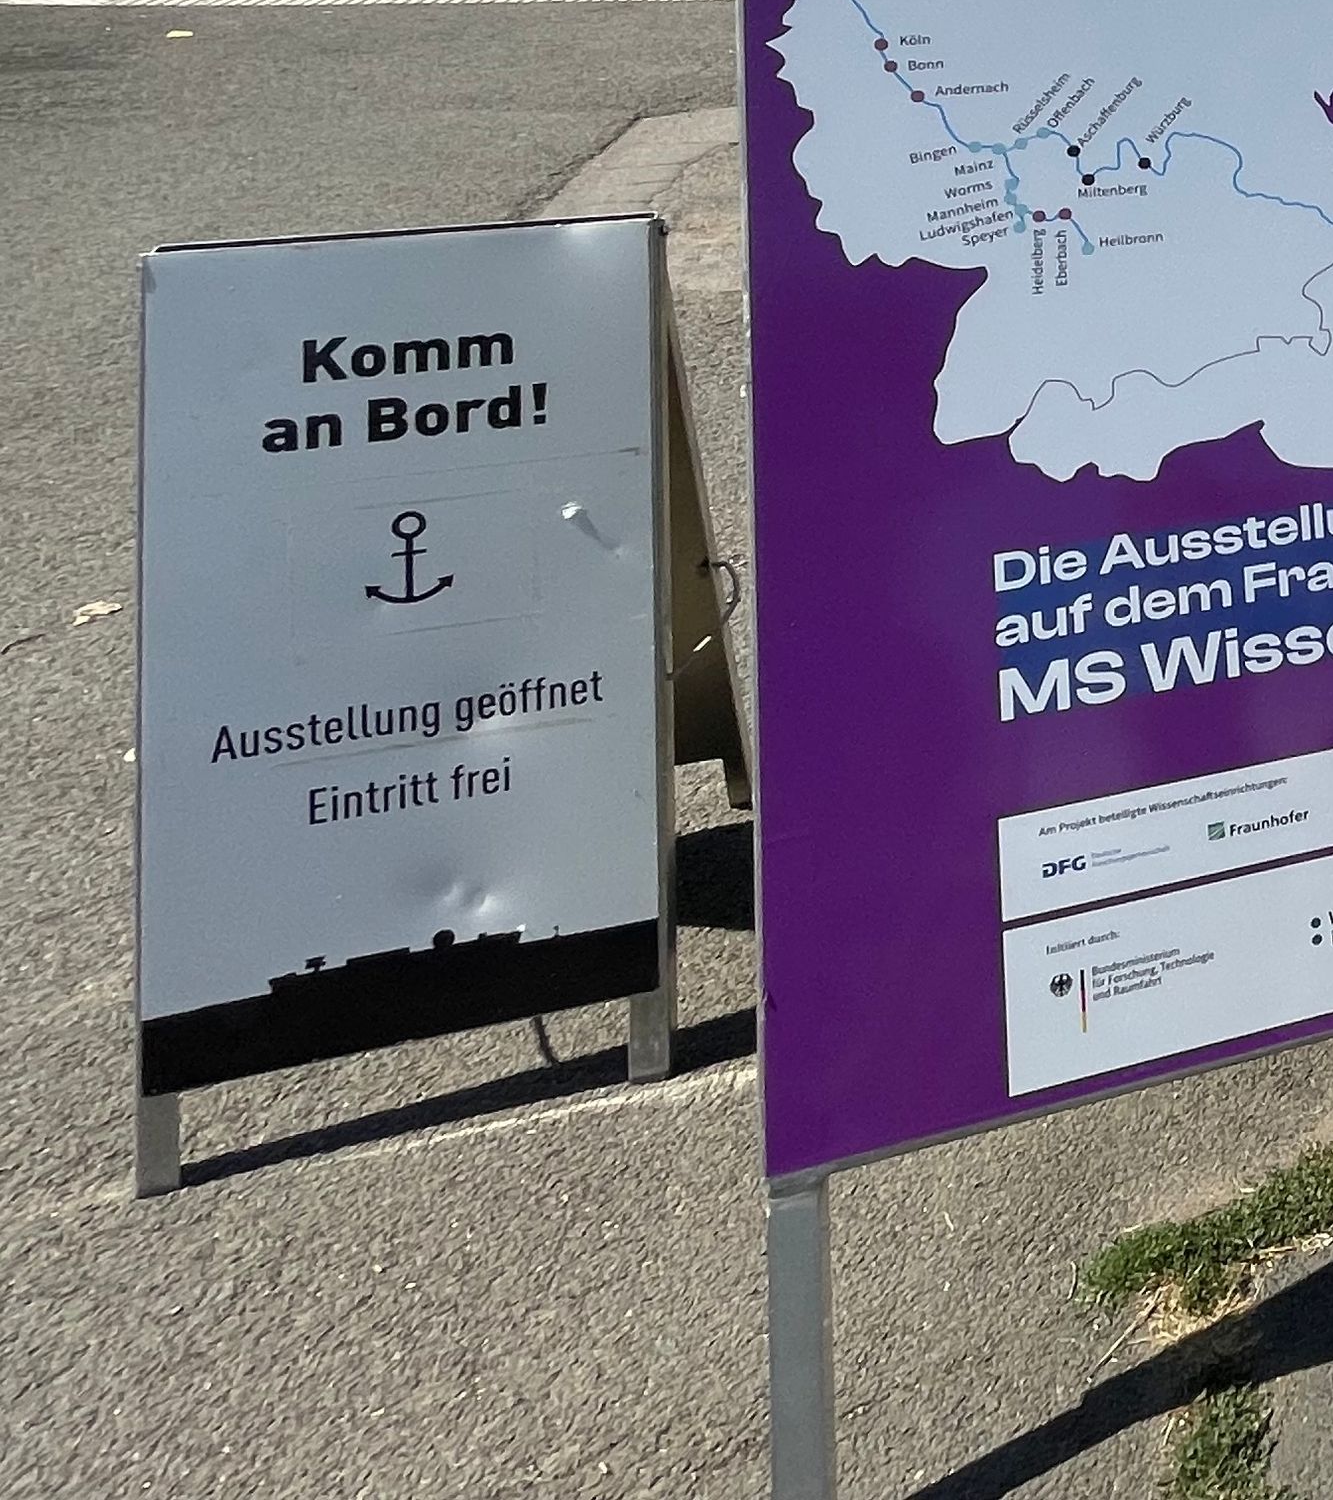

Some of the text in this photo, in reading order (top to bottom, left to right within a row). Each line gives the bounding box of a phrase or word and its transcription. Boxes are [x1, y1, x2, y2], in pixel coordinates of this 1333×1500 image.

[899, 33, 931, 47] Köln
[907, 58, 944, 72] Bonn
[934, 80, 1009, 97] Andernach
[1012, 72, 1071, 135] Rüsselsheim
[1046, 76, 1096, 129] Offenbach
[1077, 76, 1143, 149] Aschaffenburg
[1144, 96, 1192, 145] Würzburg
[909, 145, 957, 165] Bingen
[954, 159, 994, 177] Mainz
[943, 180, 993, 200] Worms
[1077, 184, 1149, 199] Miltenberg
[919, 209, 1014, 241] Ludwigshafen
[926, 197, 999, 223] Mannheim
[961, 226, 1009, 248] Speyer
[1099, 232, 1164, 248] Heilbronn
[1031, 228, 1047, 296] Heidelberg
[1055, 229, 1068, 287] Eberbach
[302, 330, 514, 383] Komm
[261, 382, 548, 453] an Bord!
[993, 545, 1089, 592] Die
[995, 595, 1094, 648] auf
[1104, 574, 1233, 627] dem
[998, 648, 1128, 723] MS
[210, 670, 604, 763] Ausstellung geöffnet
[308, 757, 512, 825] Eintritt frei
[1038, 826, 1057, 837] Am
[1058, 815, 1097, 833] Projekt
[1229, 808, 1310, 837] Fraunhofer
[1042, 855, 1087, 879] DFG
